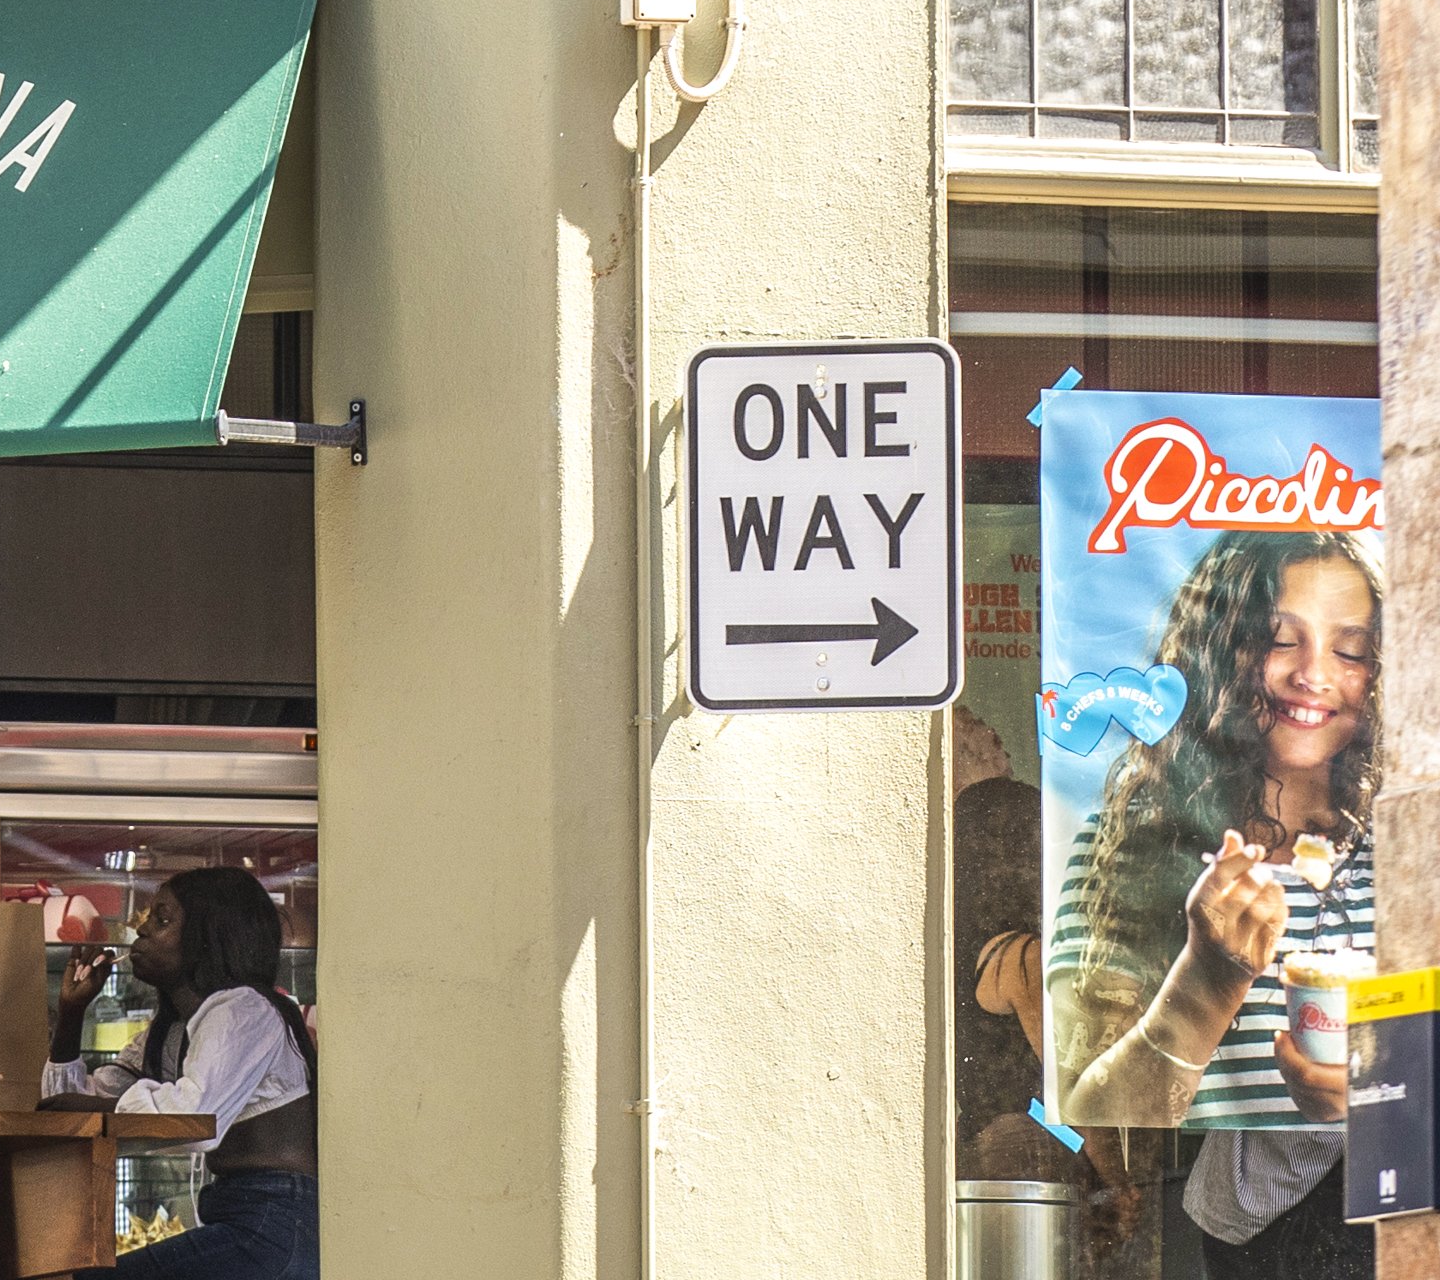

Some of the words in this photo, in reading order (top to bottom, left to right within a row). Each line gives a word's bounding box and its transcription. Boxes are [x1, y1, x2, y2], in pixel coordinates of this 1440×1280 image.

[732, 380, 911, 461] ONE
[720, 492, 926, 573] WAY
[1060, 720, 1072, 733] 8
[1066, 687, 1105, 722] CHEFS
[1107, 686, 1116, 699] 8
[1118, 686, 1165, 717] WEEKS
